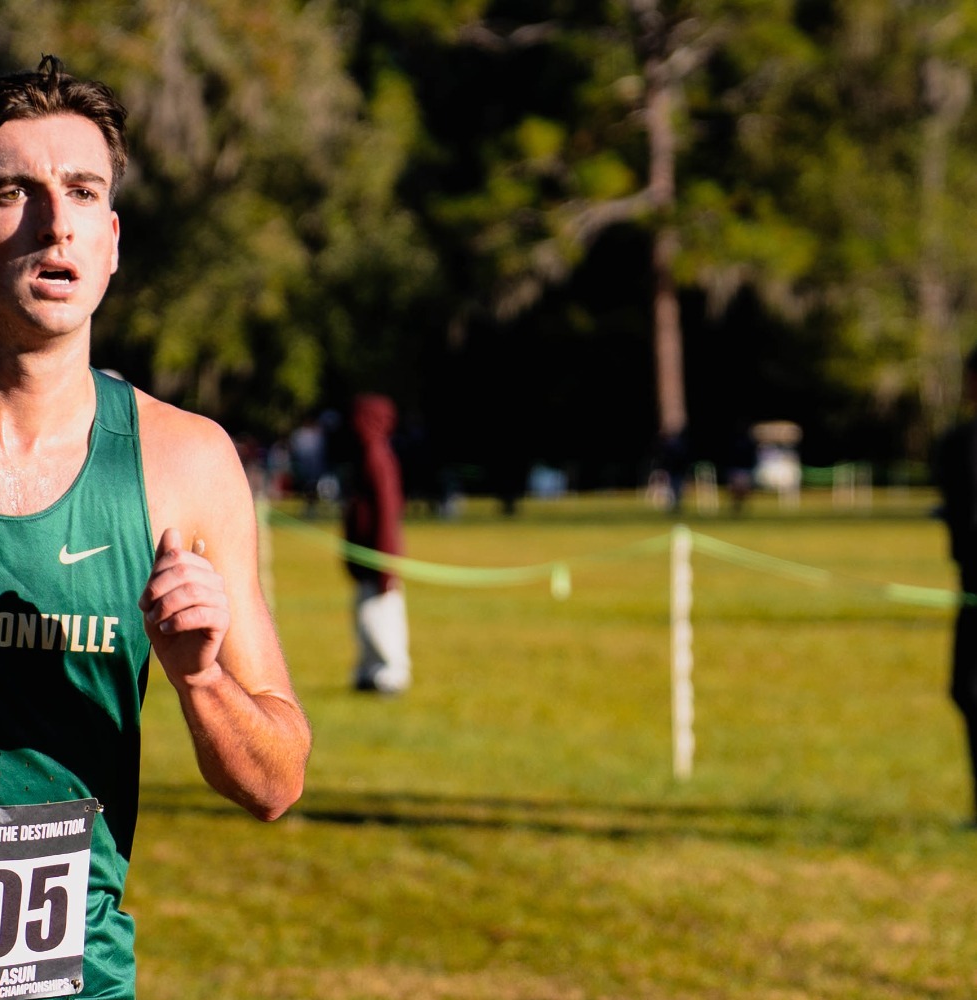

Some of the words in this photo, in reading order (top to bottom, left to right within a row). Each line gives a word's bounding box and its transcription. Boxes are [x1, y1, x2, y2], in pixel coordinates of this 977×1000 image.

[20, 818, 86, 841] DESTINATION.
[0, 964, 37, 987] ASUN
[0, 977, 71, 997] CHAMPIONSHIPS
